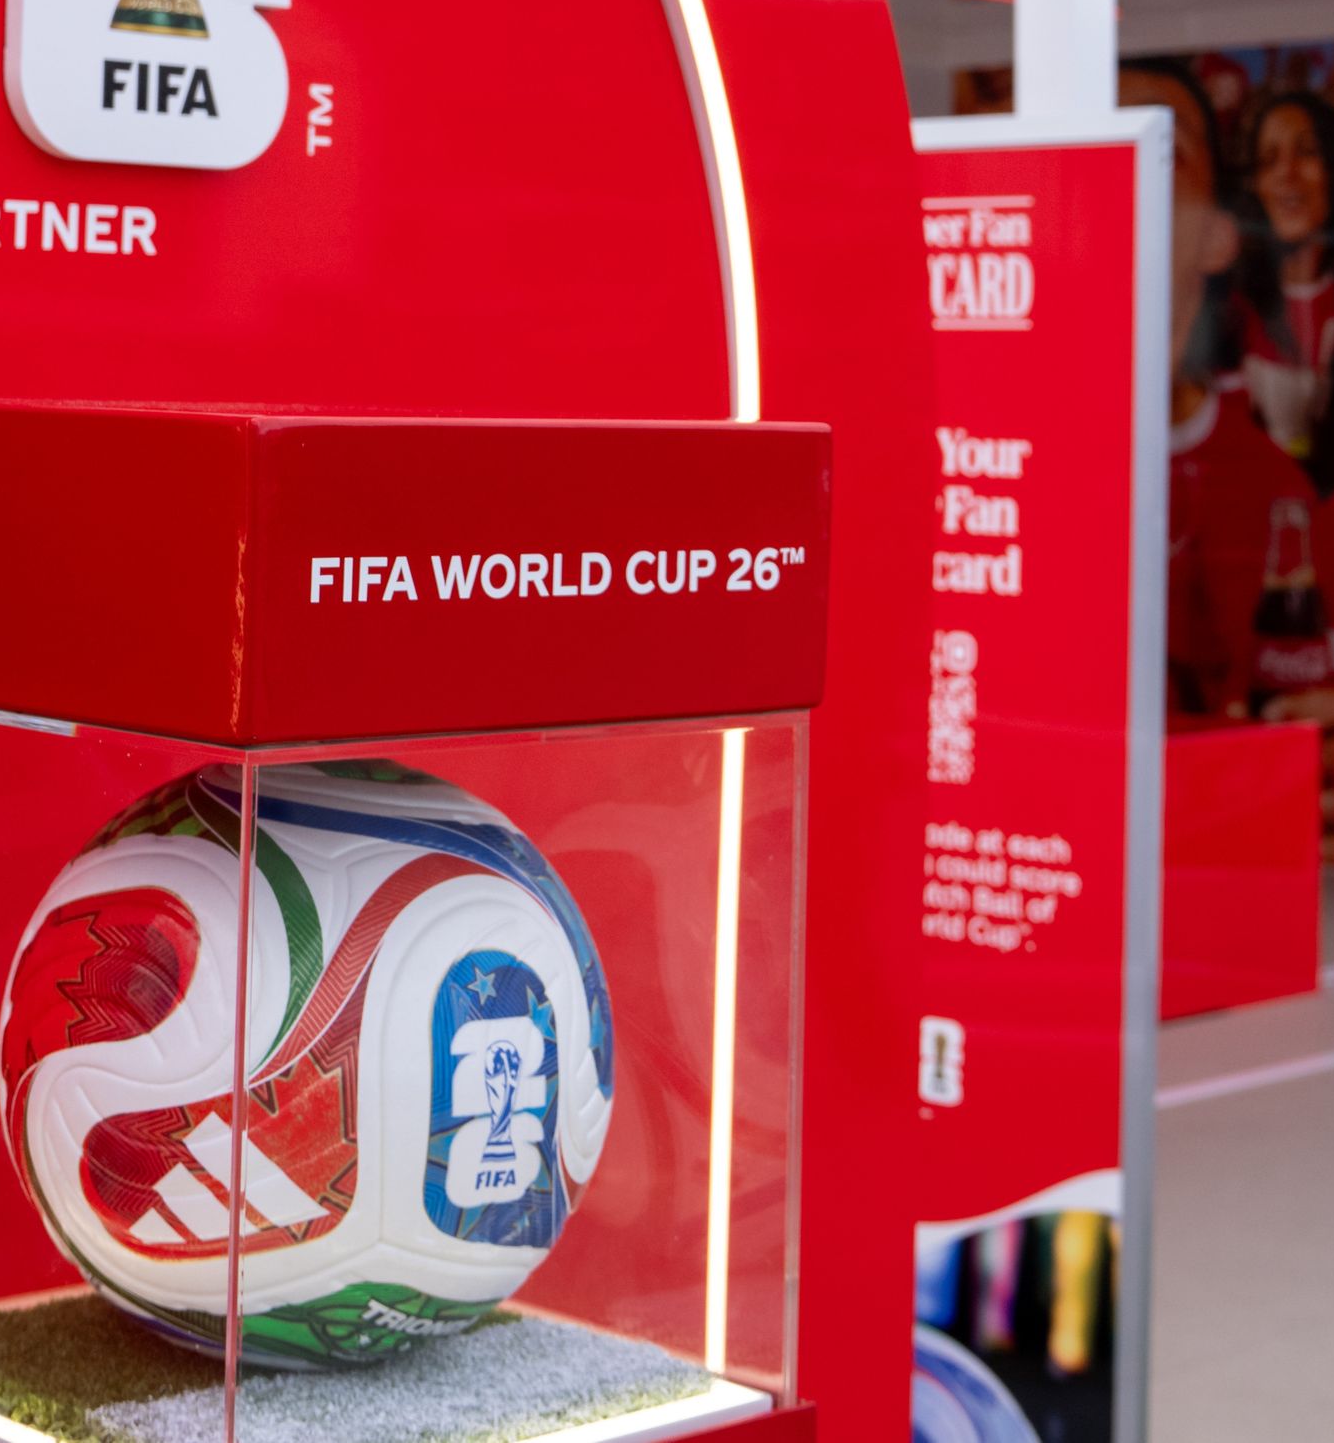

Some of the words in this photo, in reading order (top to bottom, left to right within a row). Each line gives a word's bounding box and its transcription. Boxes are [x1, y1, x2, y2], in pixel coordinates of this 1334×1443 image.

[101, 58, 219, 119] FIFA
[969, 208, 1031, 247] Fan
[927, 252, 1035, 319] CARD
[935, 426, 1033, 479] Your
[943, 484, 1019, 537] Fan
[310, 556, 418, 603] FIFA
[431, 553, 612, 600] WORLD
[625, 550, 717, 595] CUP
[475, 1169, 517, 1190] FIFA
[361, 1298, 479, 1336] TRION
